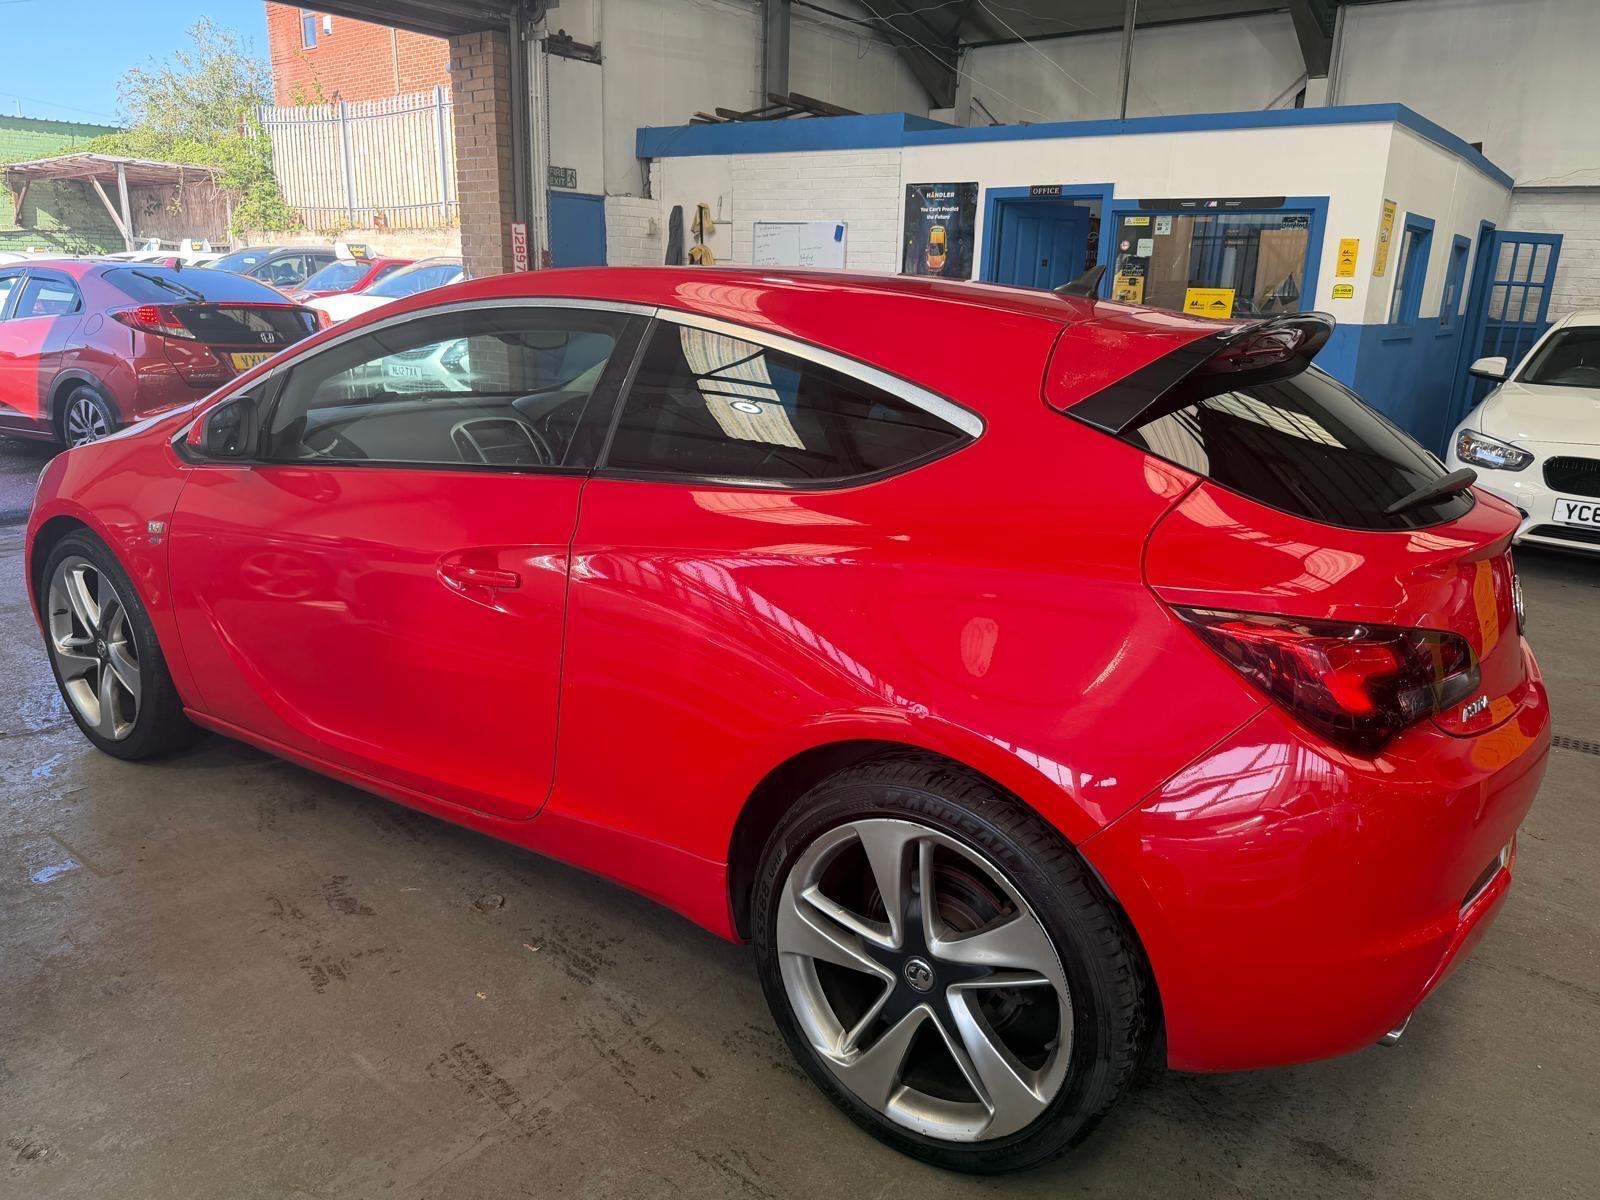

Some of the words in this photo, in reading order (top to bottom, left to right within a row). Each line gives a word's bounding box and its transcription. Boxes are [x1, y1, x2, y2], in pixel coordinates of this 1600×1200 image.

[550, 168, 566, 177] FIRE
[550, 177, 565, 185] EXIT
[1032, 187, 1060, 195] OFFICE
[514, 226, 526, 272] J2897
[1565, 503, 1600, 523] YC6
